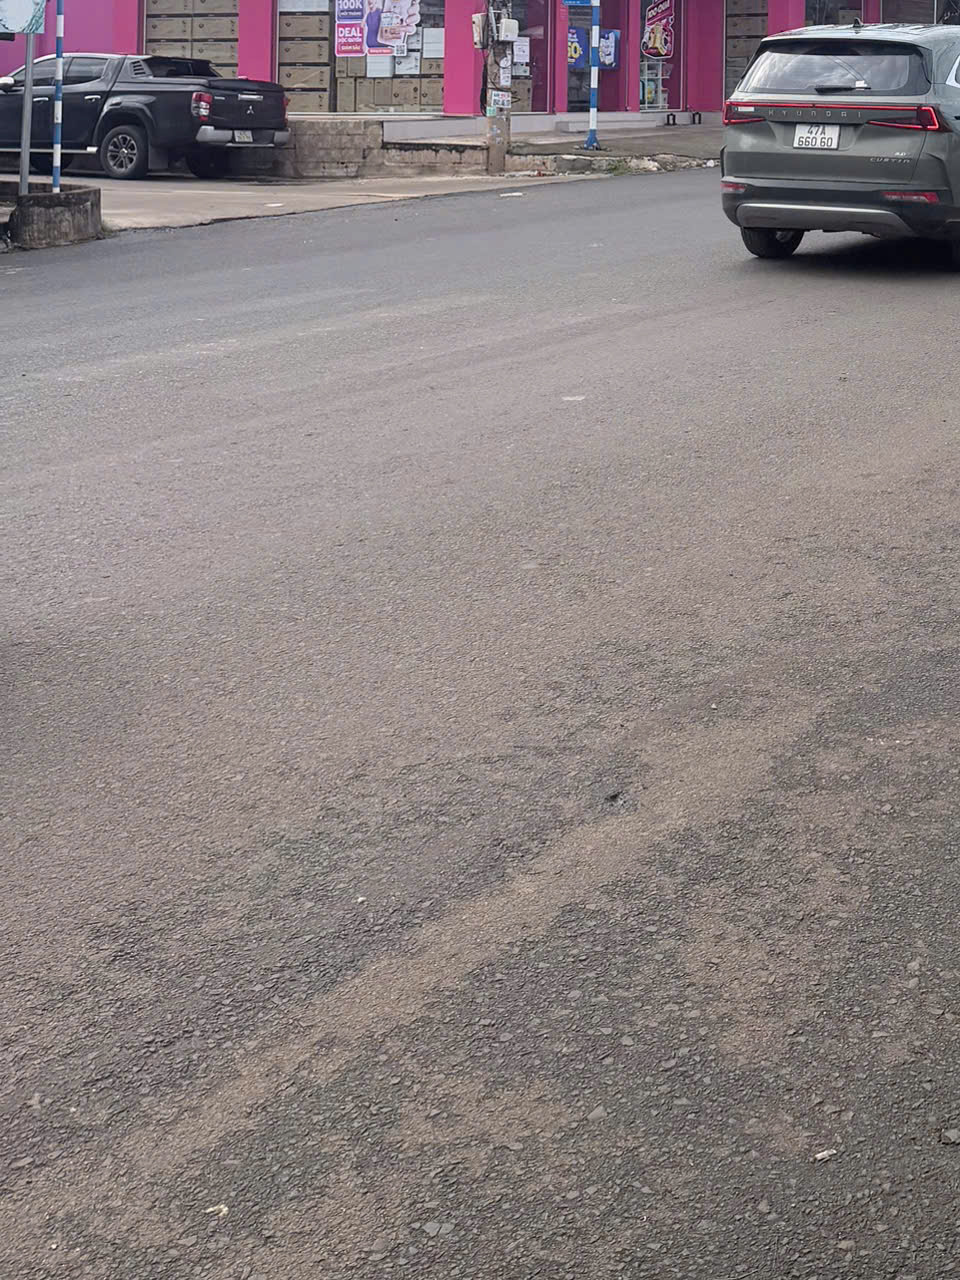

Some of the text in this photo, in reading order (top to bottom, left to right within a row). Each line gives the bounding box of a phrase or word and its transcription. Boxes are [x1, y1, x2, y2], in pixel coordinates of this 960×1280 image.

[338, 0, 363, 9] 100K
[338, 27, 363, 37] DEAL
[768, 109, 862, 118] HYUNDAI
[807, 124, 827, 135] 47A
[797, 136, 833, 148] 660.60
